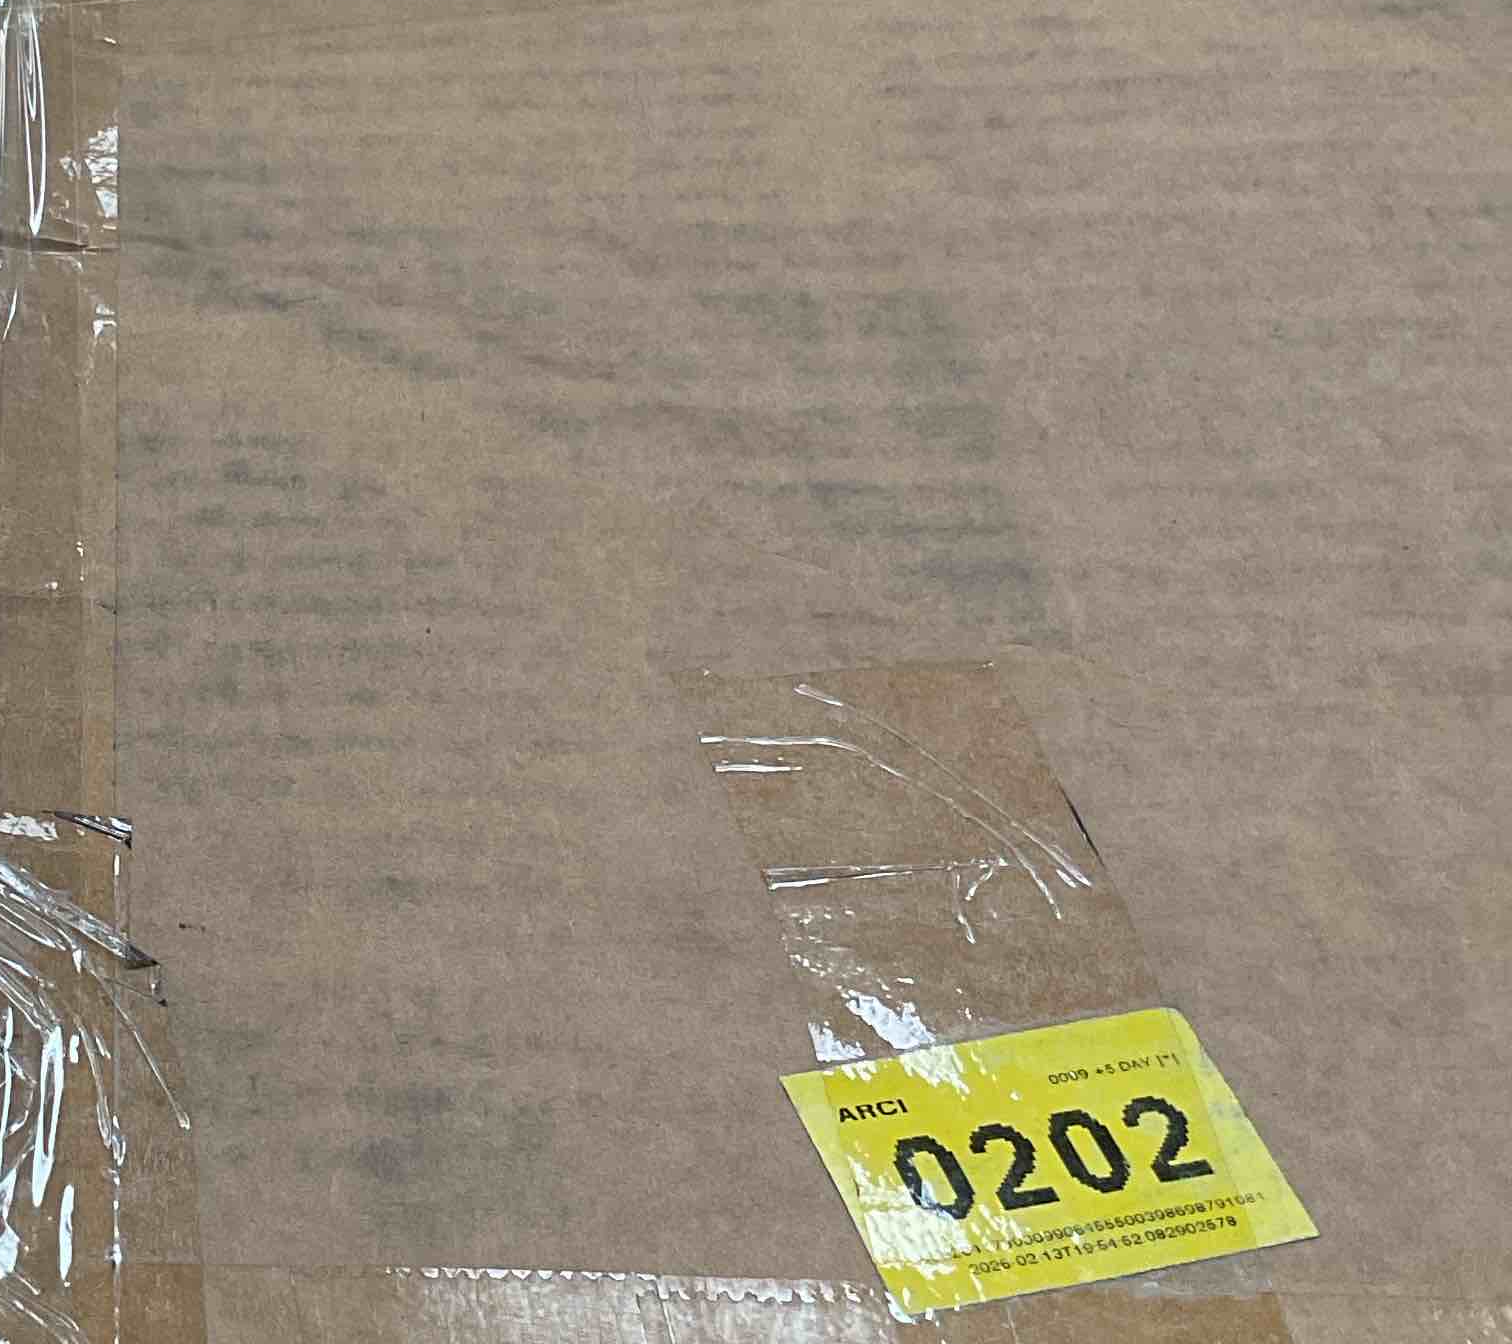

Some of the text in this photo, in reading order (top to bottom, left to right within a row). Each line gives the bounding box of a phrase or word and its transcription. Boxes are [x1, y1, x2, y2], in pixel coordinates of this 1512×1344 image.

[1118, 1057, 1151, 1073] DAY
[838, 1098, 908, 1123] ARCI
[893, 1094, 1216, 1221] 0202
